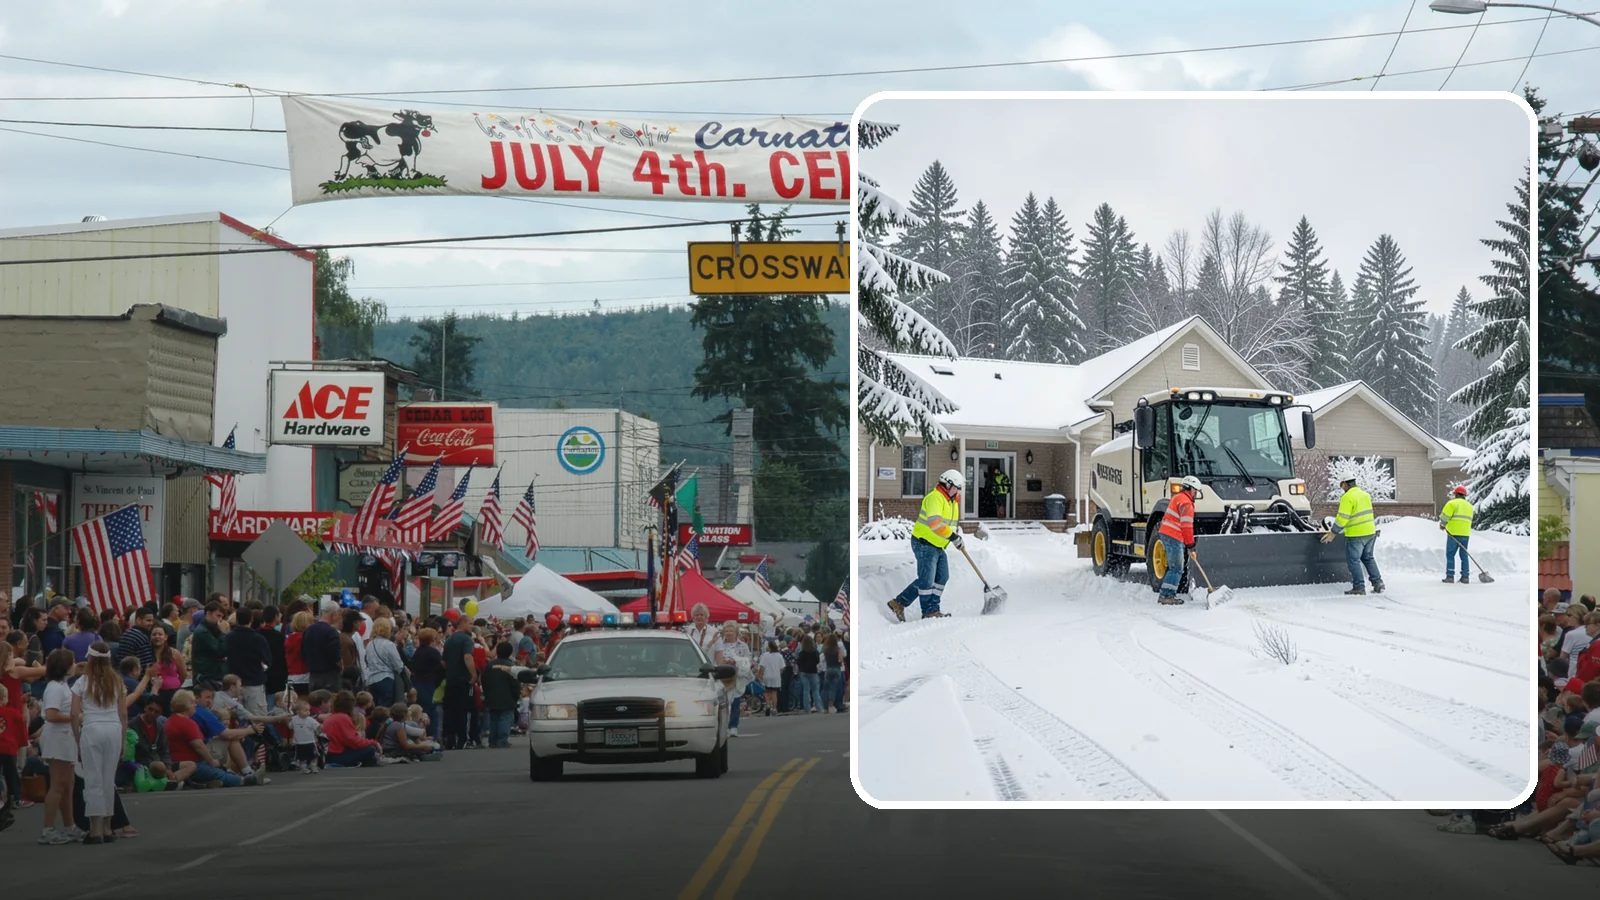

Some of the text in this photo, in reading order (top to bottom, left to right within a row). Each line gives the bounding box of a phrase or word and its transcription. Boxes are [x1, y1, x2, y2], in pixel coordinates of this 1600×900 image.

[481, 141, 605, 193] JULY
[632, 150, 747, 198] 4th.
[697, 254, 850, 280] CROSSWA
[282, 380, 373, 420] ACE
[405, 409, 453, 422] CEDAR
[283, 421, 370, 436] Hardware
[353, 467, 385, 480] Simpl
[96, 485, 124, 494] Vincent
[126, 485, 136, 494] de
[137, 485, 155, 495] Paul
[688, 526, 741, 535] CRNATION
[699, 535, 731, 544] GLASS
